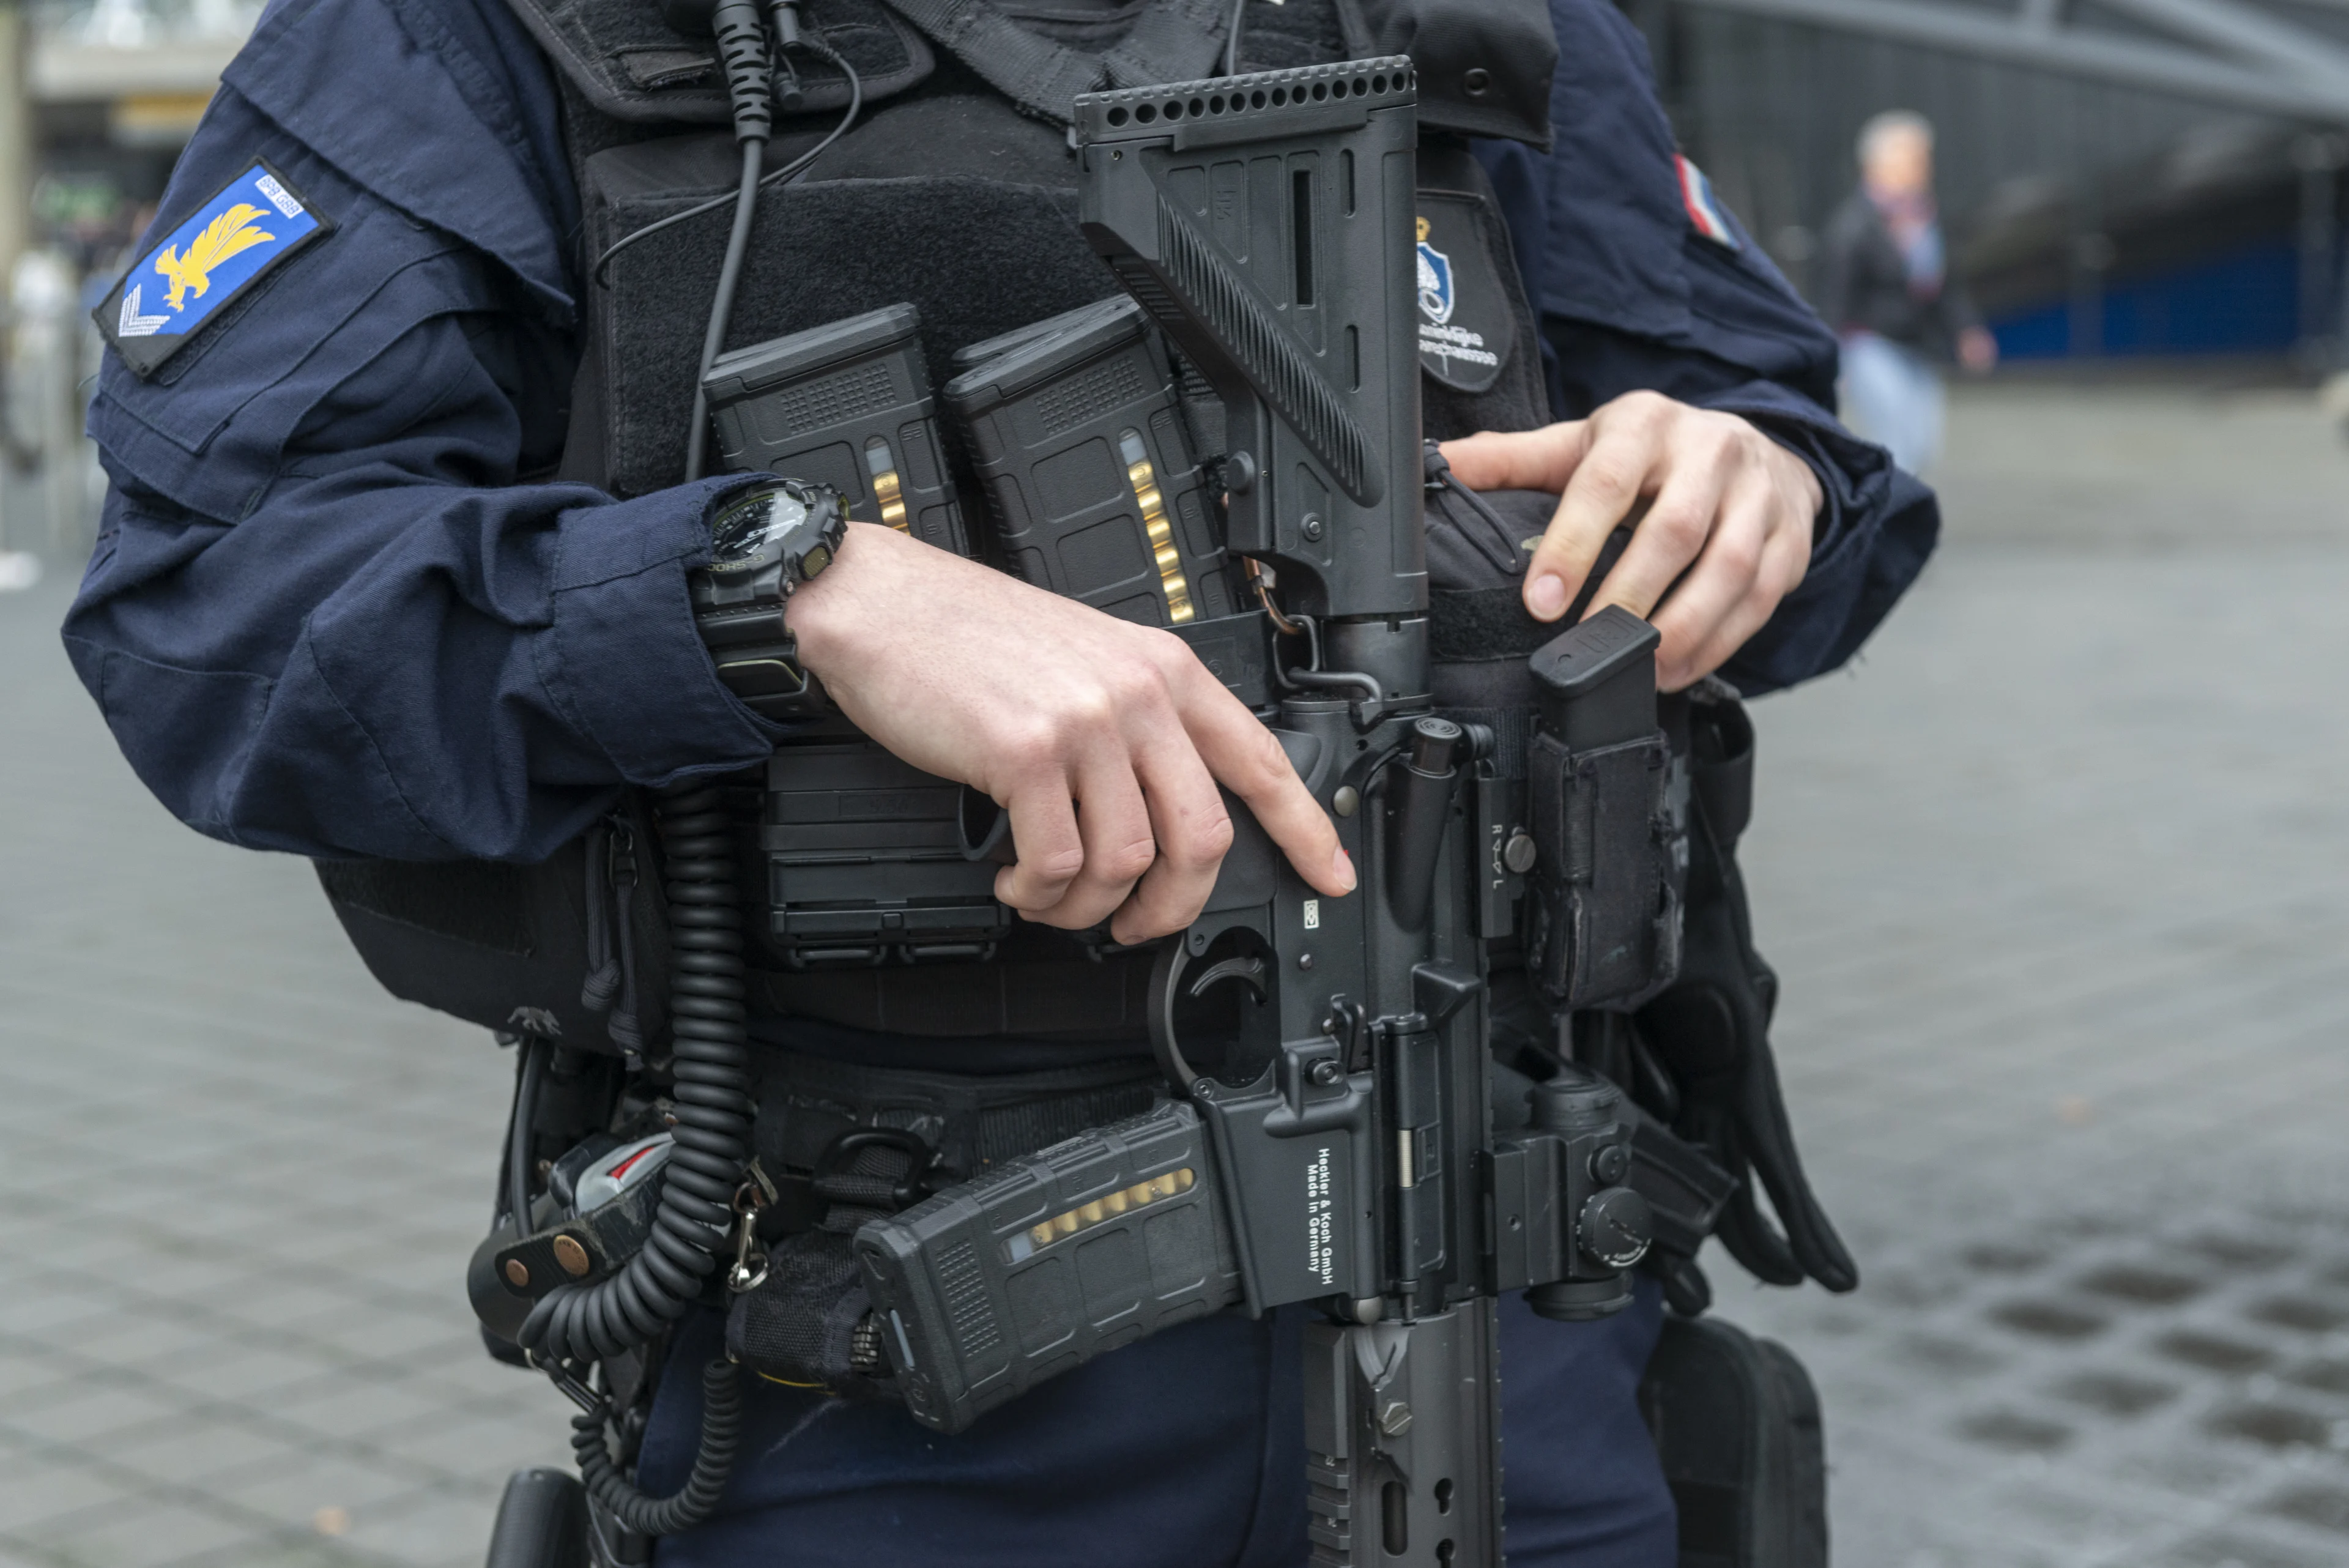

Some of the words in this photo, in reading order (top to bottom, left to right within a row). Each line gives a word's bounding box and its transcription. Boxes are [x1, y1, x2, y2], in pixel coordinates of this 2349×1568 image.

[707, 554, 765, 571] G-SHOC
[1491, 825, 1502, 834] R
[1493, 880, 1504, 890] L
[1307, 1164, 1319, 1197] Made
[1318, 1148, 1330, 1195] Heckler
[1320, 1200, 1331, 1208] &
[1321, 1212, 1332, 1243] Koch
[1308, 1217, 1320, 1272] Germany
[1321, 1247, 1333, 1285] GmbH
